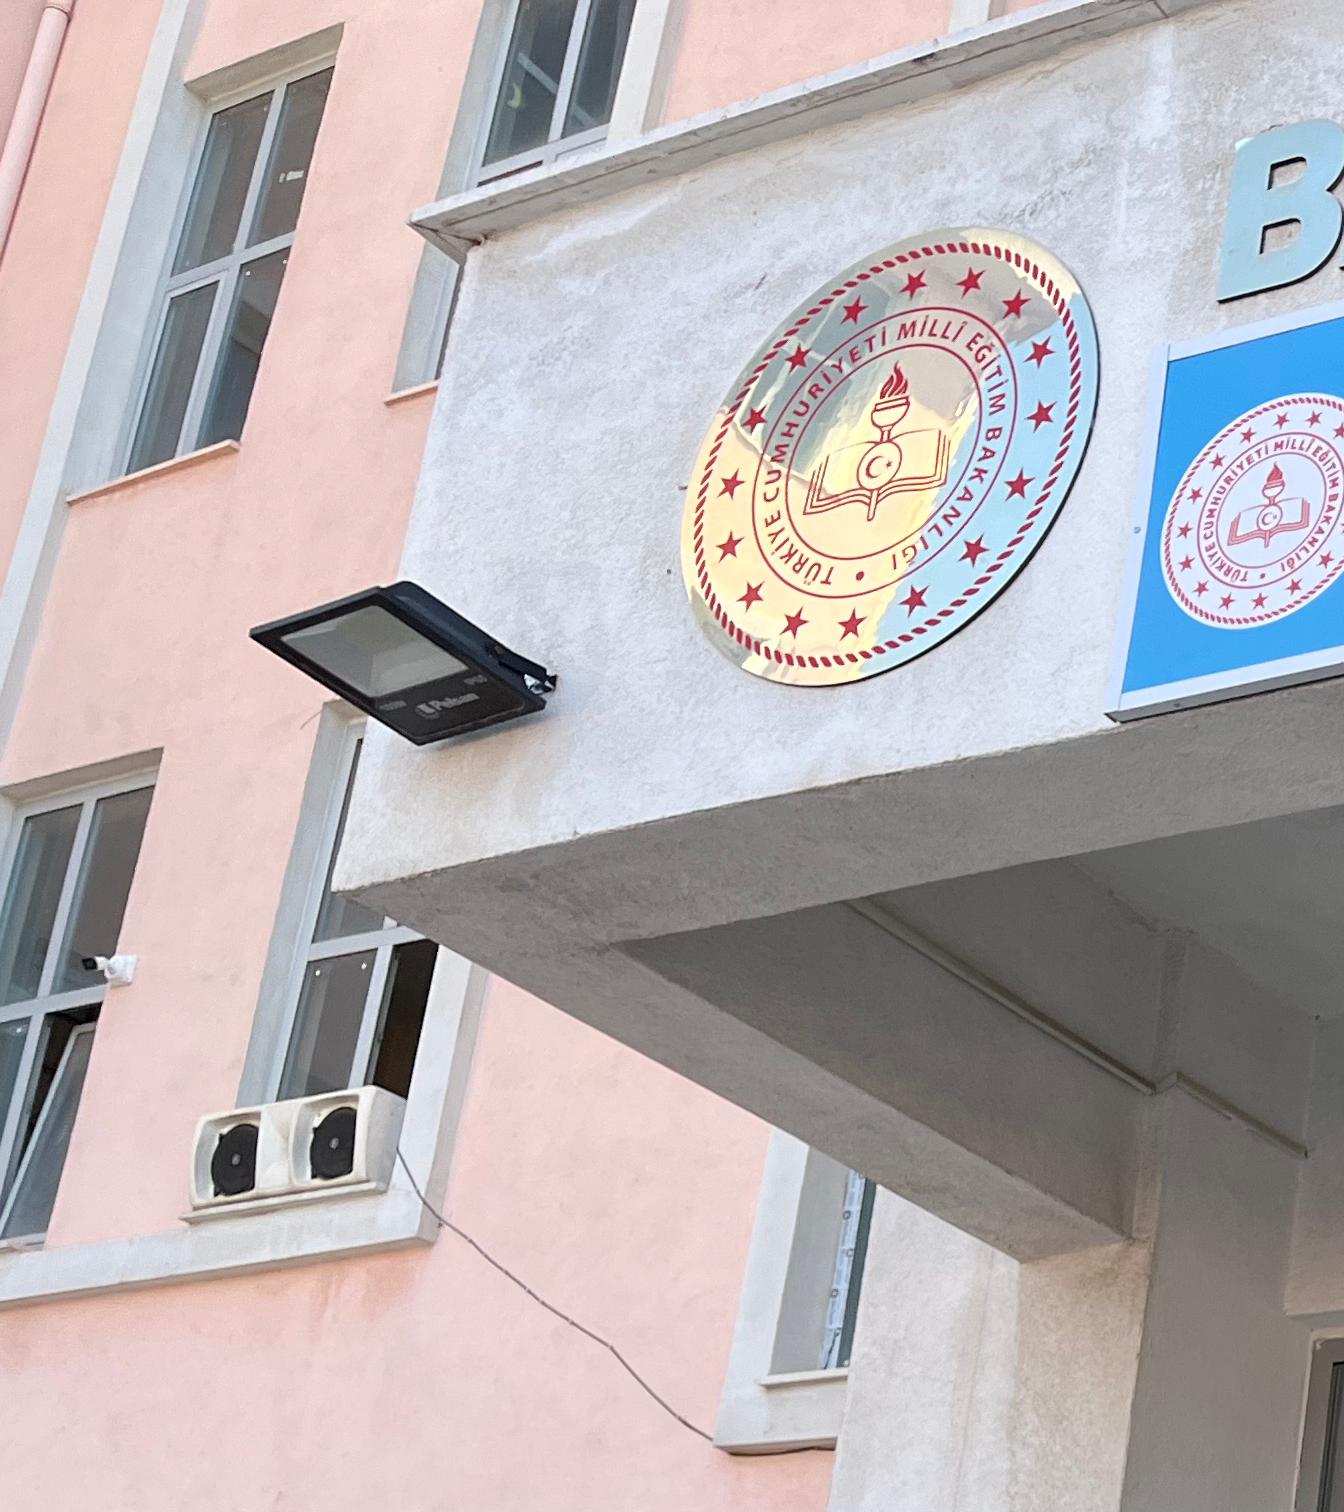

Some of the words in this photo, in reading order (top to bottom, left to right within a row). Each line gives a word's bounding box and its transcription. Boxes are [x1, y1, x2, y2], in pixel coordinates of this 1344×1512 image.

[898, 314, 967, 341] MİLLÎ
[765, 323, 888, 502] CUMHURİYETİ
[965, 331, 1006, 415] EĞİTİM
[890, 427, 1003, 571] BAKANLIĞI
[765, 509, 835, 586] TÜRKİYE
